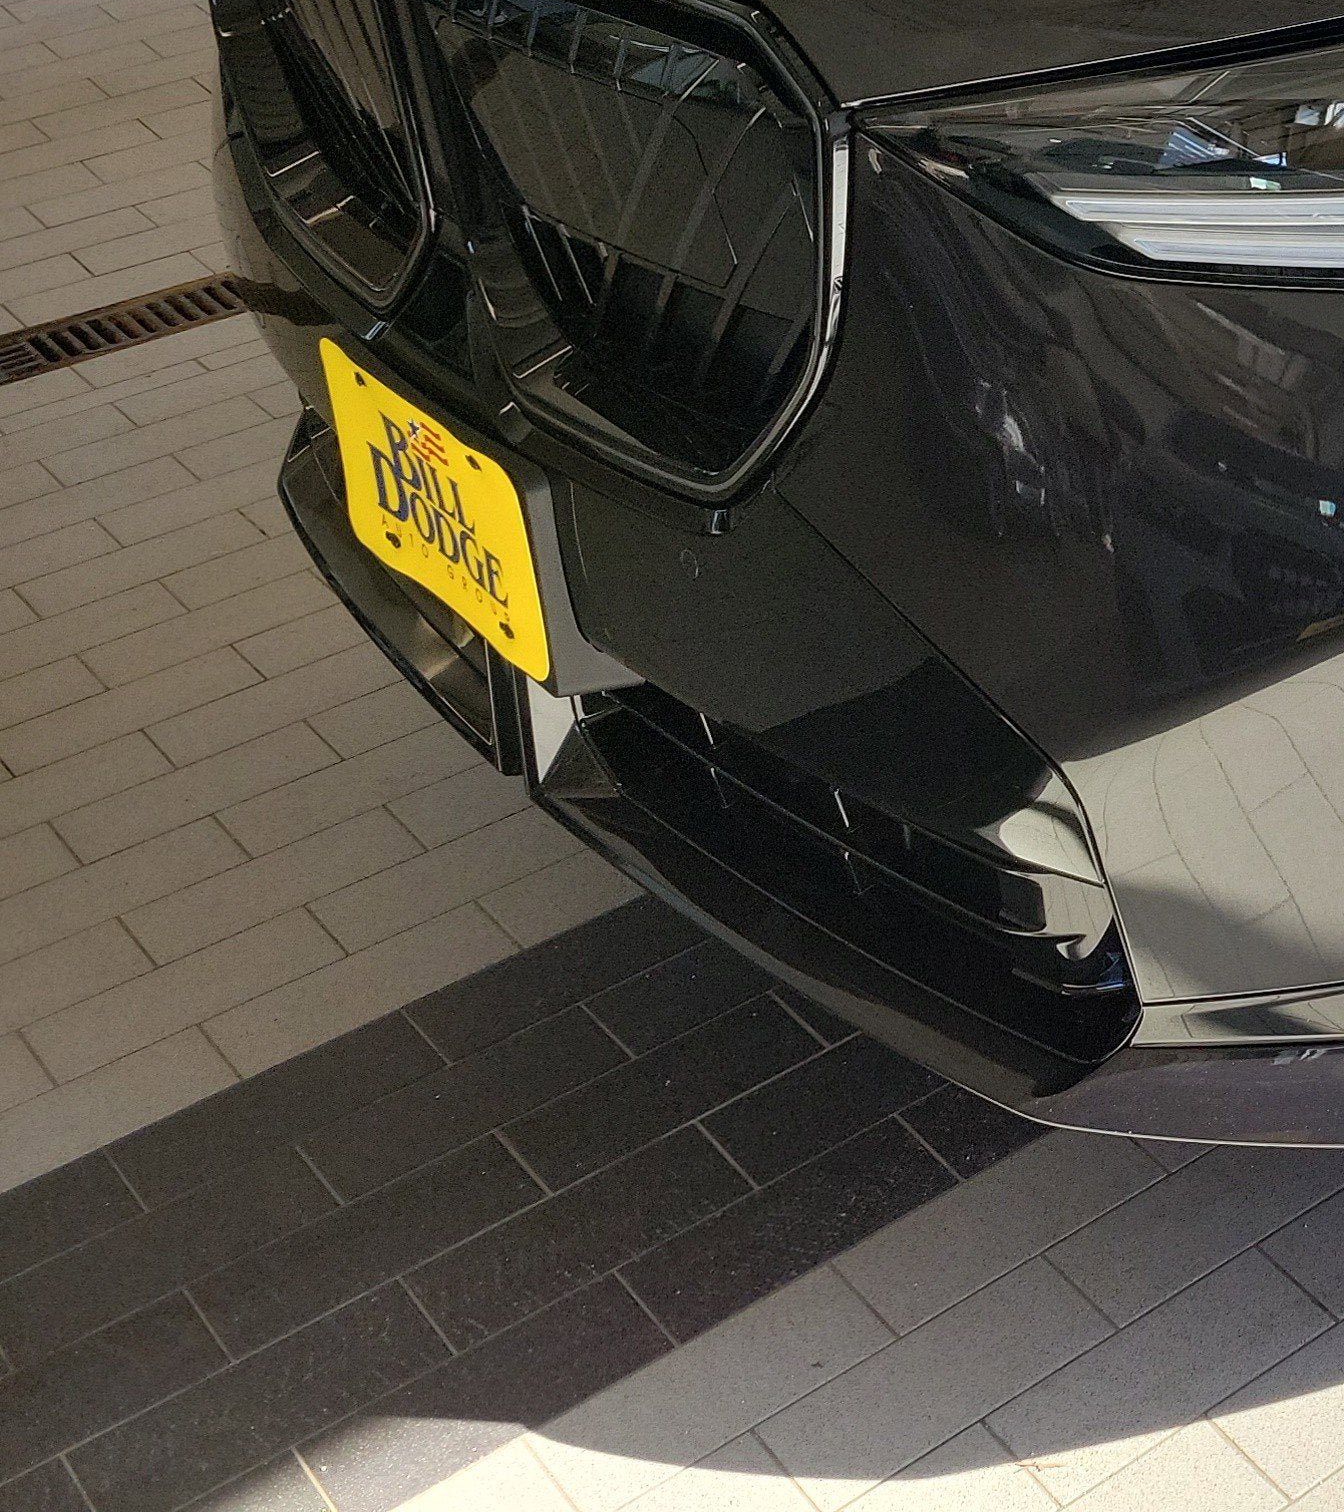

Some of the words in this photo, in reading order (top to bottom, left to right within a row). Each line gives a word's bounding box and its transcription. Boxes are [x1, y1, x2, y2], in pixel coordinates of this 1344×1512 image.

[365, 439, 509, 609] DODGE
[378, 409, 476, 536] BILL
[381, 514, 430, 559] AUTO
